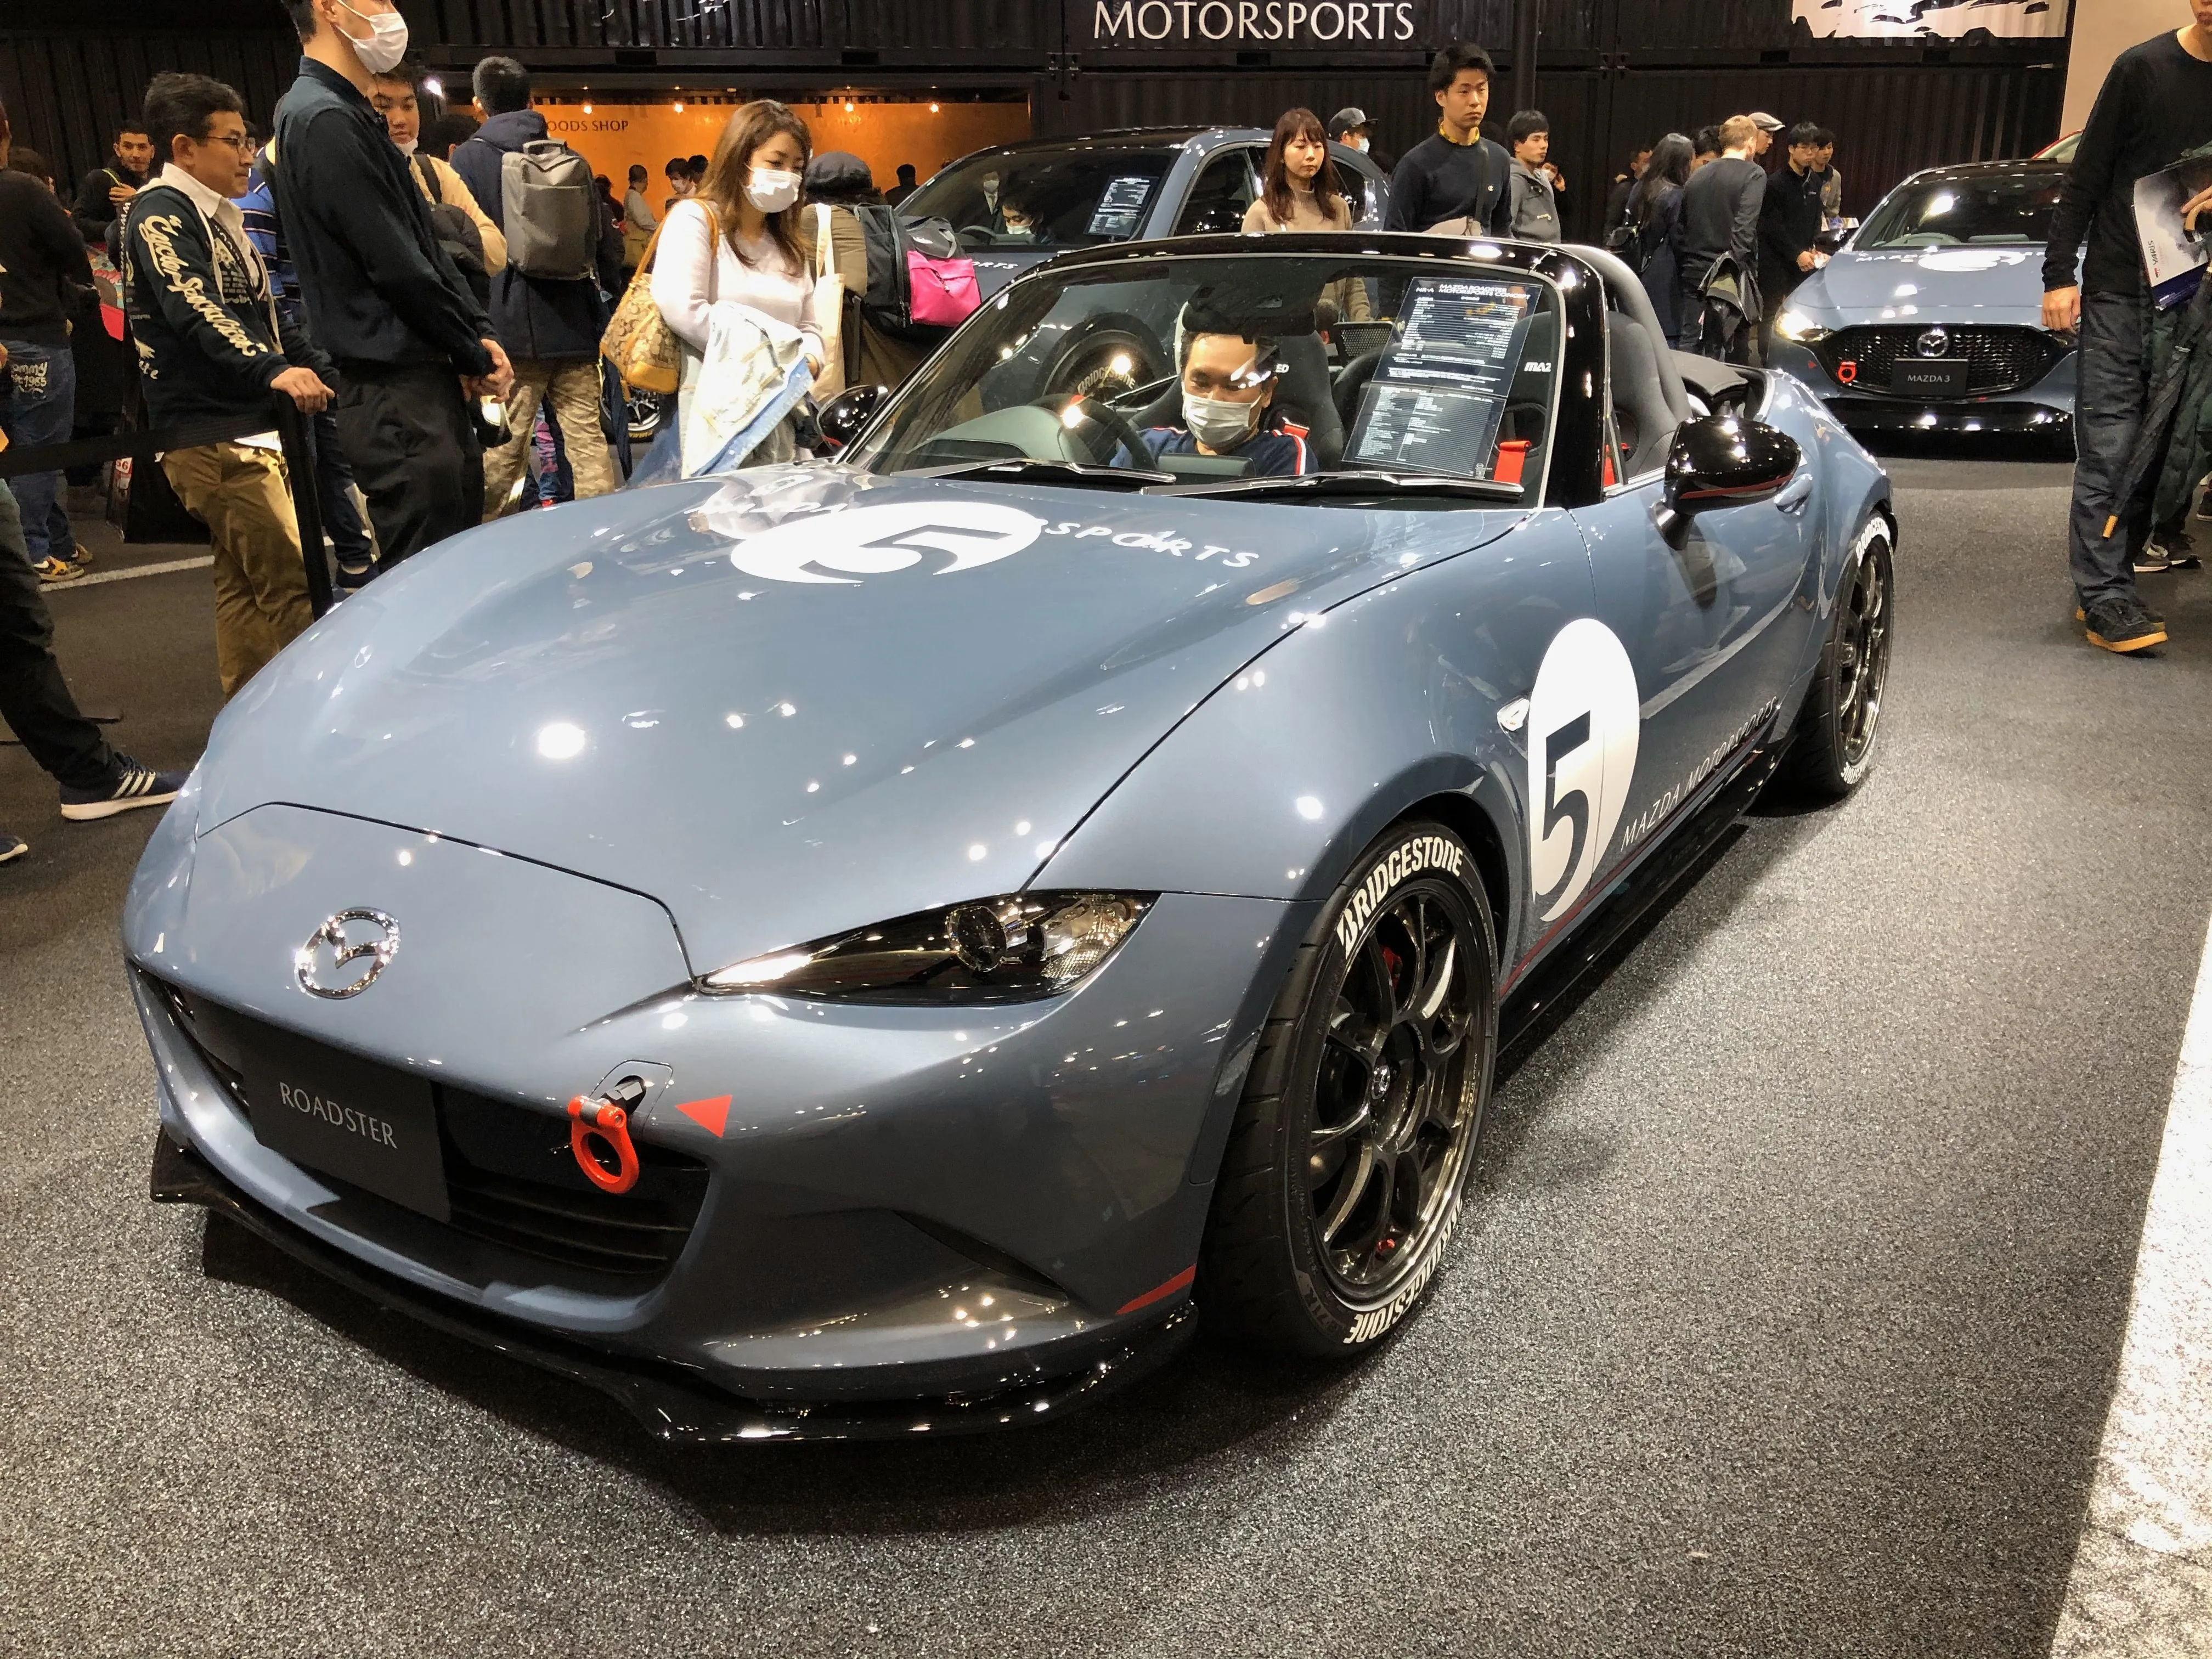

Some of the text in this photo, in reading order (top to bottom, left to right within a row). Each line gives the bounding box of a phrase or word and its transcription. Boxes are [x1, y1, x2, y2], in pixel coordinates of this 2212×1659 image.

[1094, 1, 1414, 40] MOTORSPORTS
[548, 120, 629, 132] OODS SHOP
[2148, 240, 2159, 266] YARIS
[1438, 288, 1493, 296] MOTORSPORTS
[11, 362, 48, 377] ommy
[1621, 696, 1777, 853] MAZDA MOTORSPORTS
[1535, 710, 1590, 920] 5
[1336, 837, 1464, 960] BRIDGESTONE
[279, 1082, 398, 1149] ROADSTER
